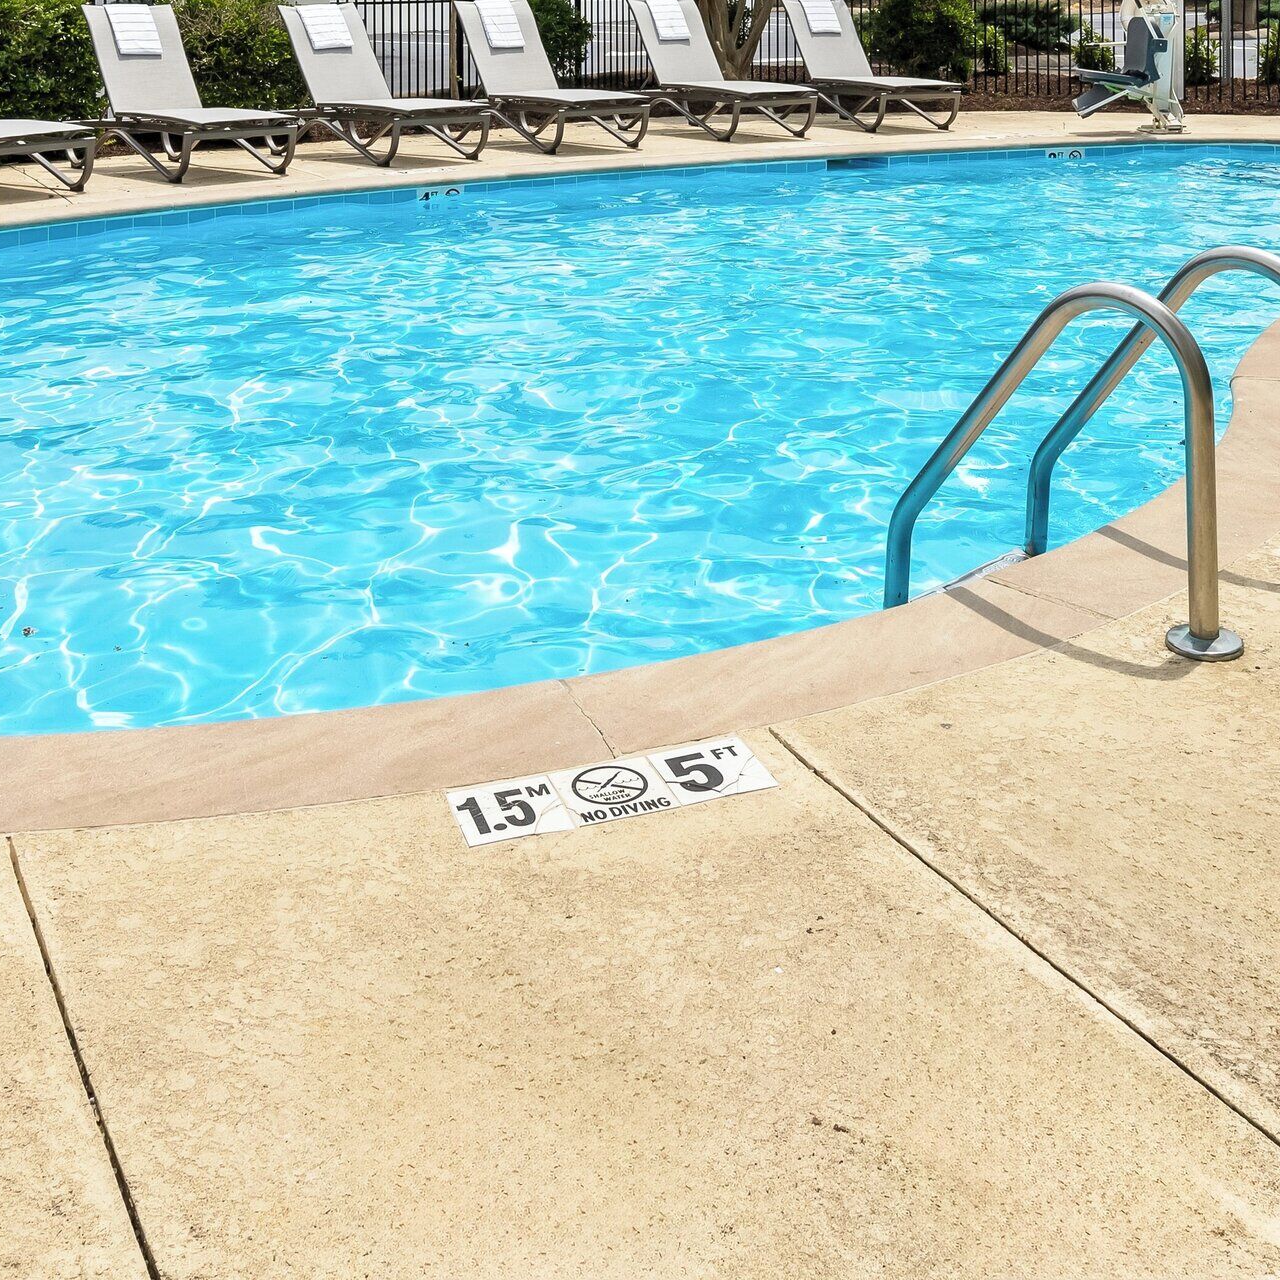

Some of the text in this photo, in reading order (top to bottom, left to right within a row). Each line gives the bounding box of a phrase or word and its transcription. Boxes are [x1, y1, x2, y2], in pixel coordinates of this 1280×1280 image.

[664, 745, 739, 792] 5 FT
[589, 788, 625, 799] SHALLOW
[603, 793, 631, 802] WATER
[456, 783, 551, 835] 1.5 M
[580, 797, 671, 823] NO DIVING
